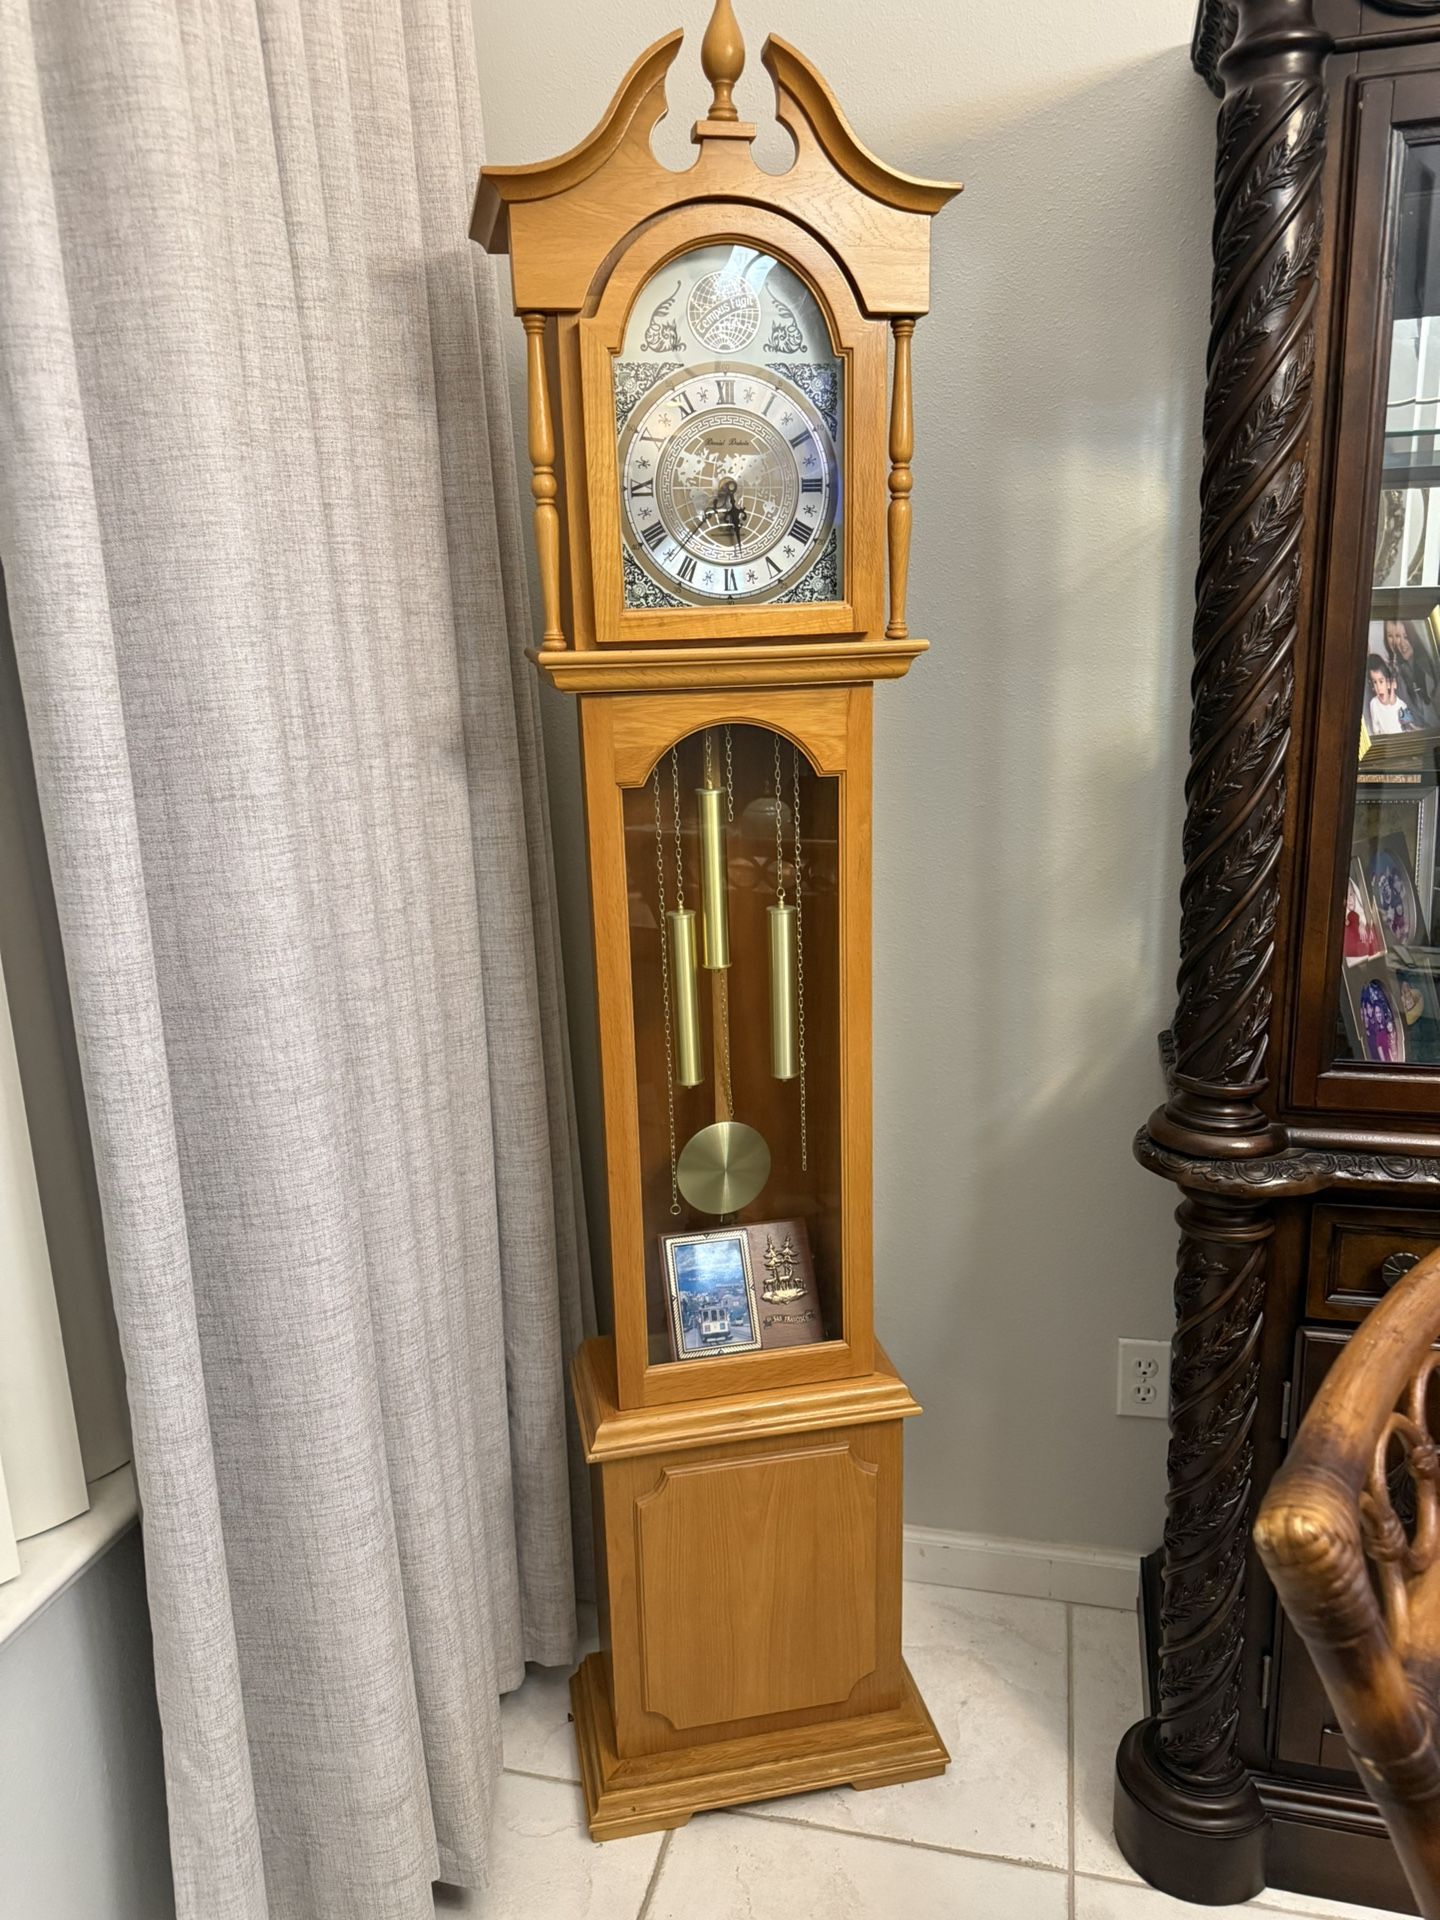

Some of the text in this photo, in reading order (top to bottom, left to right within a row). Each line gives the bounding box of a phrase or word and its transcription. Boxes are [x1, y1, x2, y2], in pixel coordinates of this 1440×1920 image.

[715, 380, 736, 405] XII
[639, 427, 667, 451] X
[787, 428, 813, 450] II
[630, 477, 654, 498] IX
[801, 477, 823, 494] III
[641, 519, 668, 552] VIII
[787, 517, 814, 546] IIII
[676, 556, 698, 584] VII
[765, 556, 783, 579] V
[724, 568, 738, 591] VI
